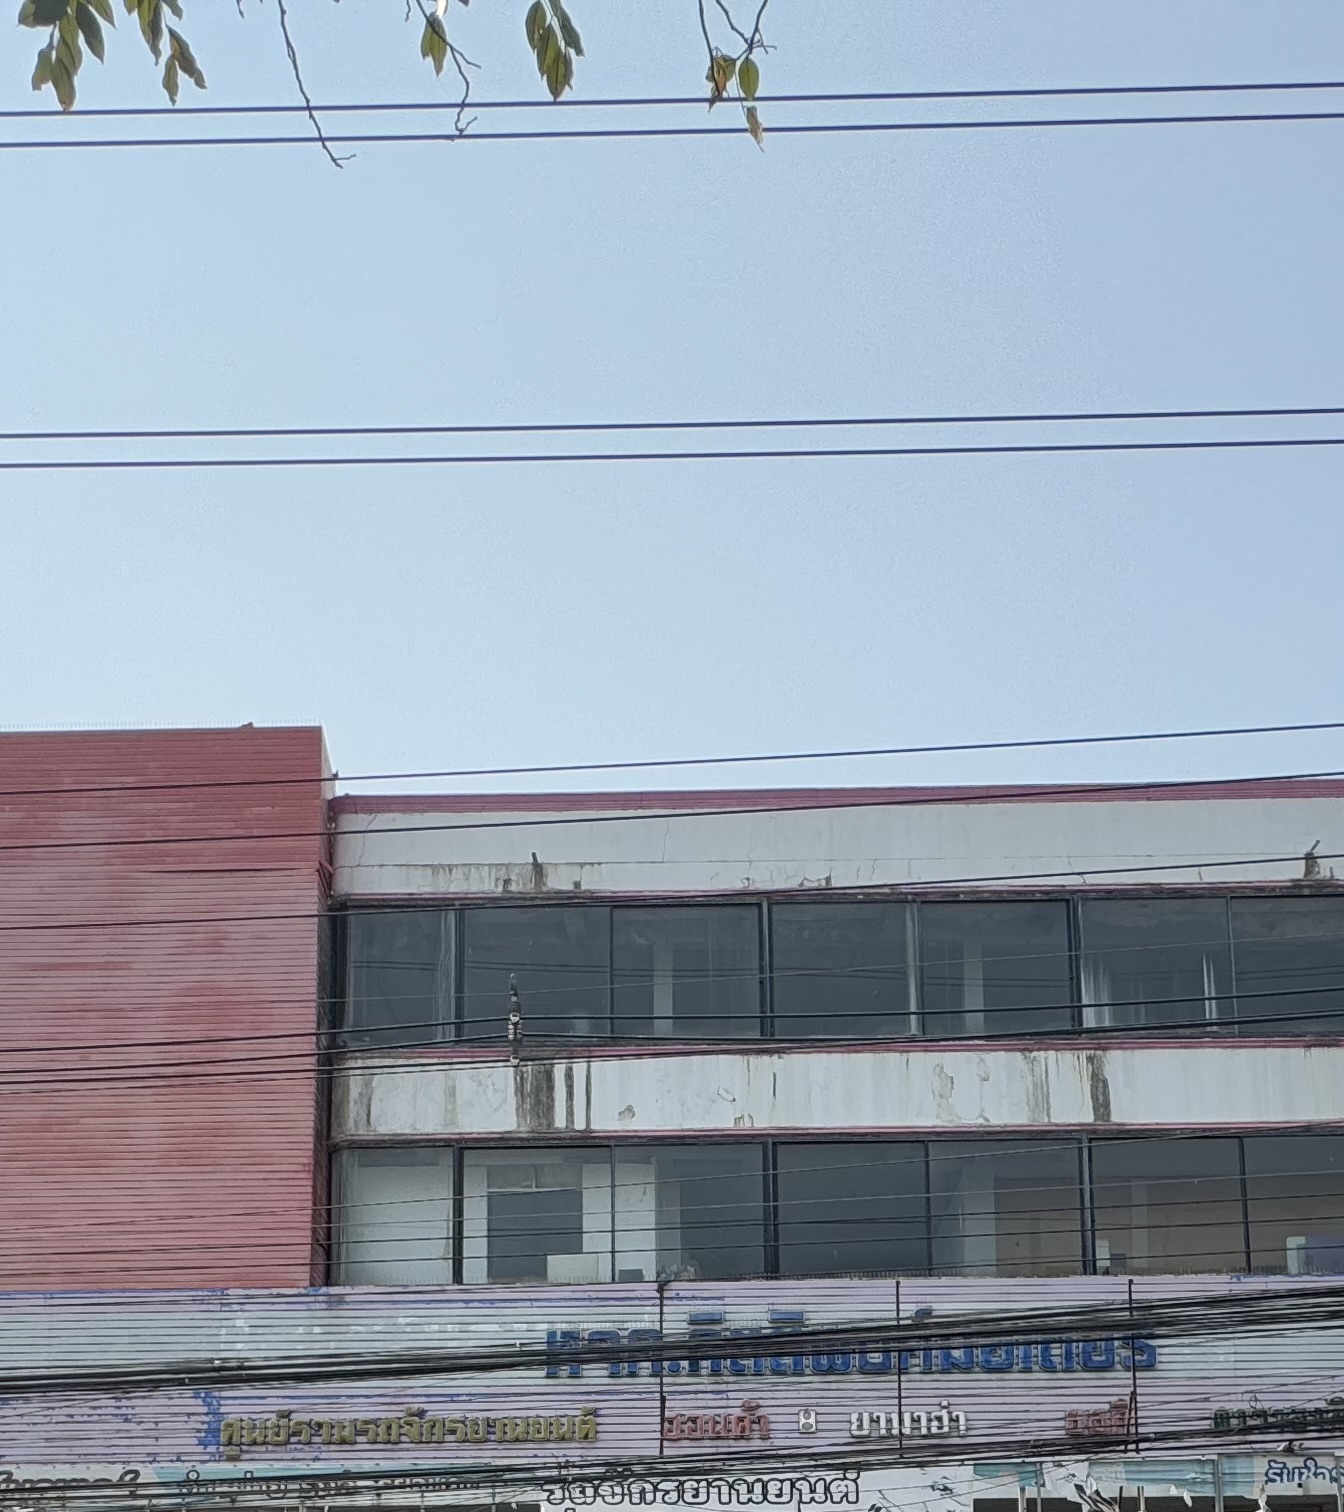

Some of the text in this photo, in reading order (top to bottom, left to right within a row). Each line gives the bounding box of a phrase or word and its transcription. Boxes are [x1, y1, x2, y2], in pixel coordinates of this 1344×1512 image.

[220, 1406, 598, 1460] ศูนย์รวมรถจักรยานยนต์
[850, 1400, 966, 1438] ยามาฮ่า
